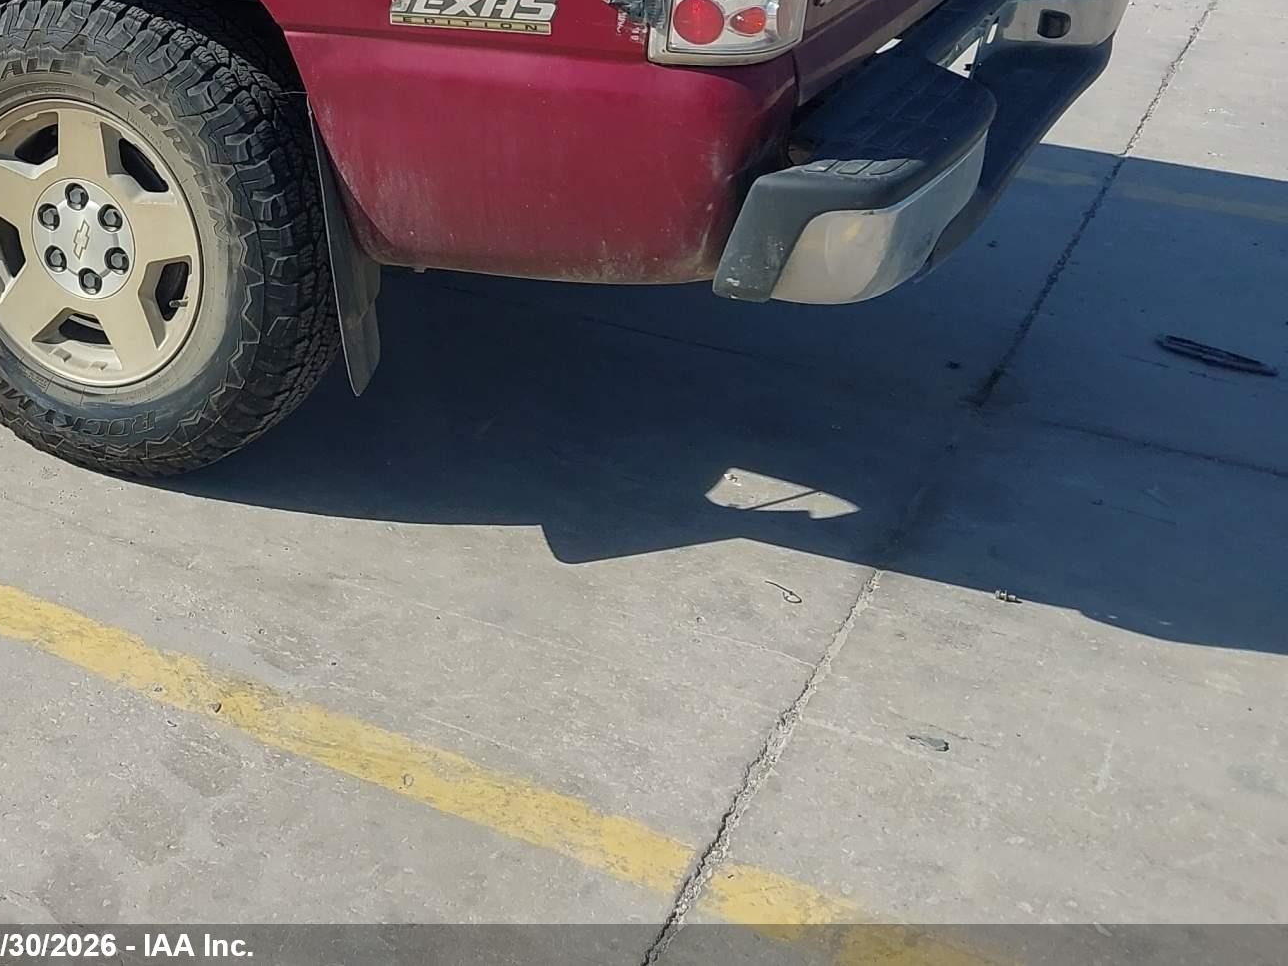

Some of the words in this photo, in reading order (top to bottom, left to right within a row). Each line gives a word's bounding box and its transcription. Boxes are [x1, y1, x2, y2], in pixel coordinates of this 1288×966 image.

[402, 15, 538, 32] EDITION
[0, 57, 73, 82] ALL
[34, 408, 158, 436] ROCKY
